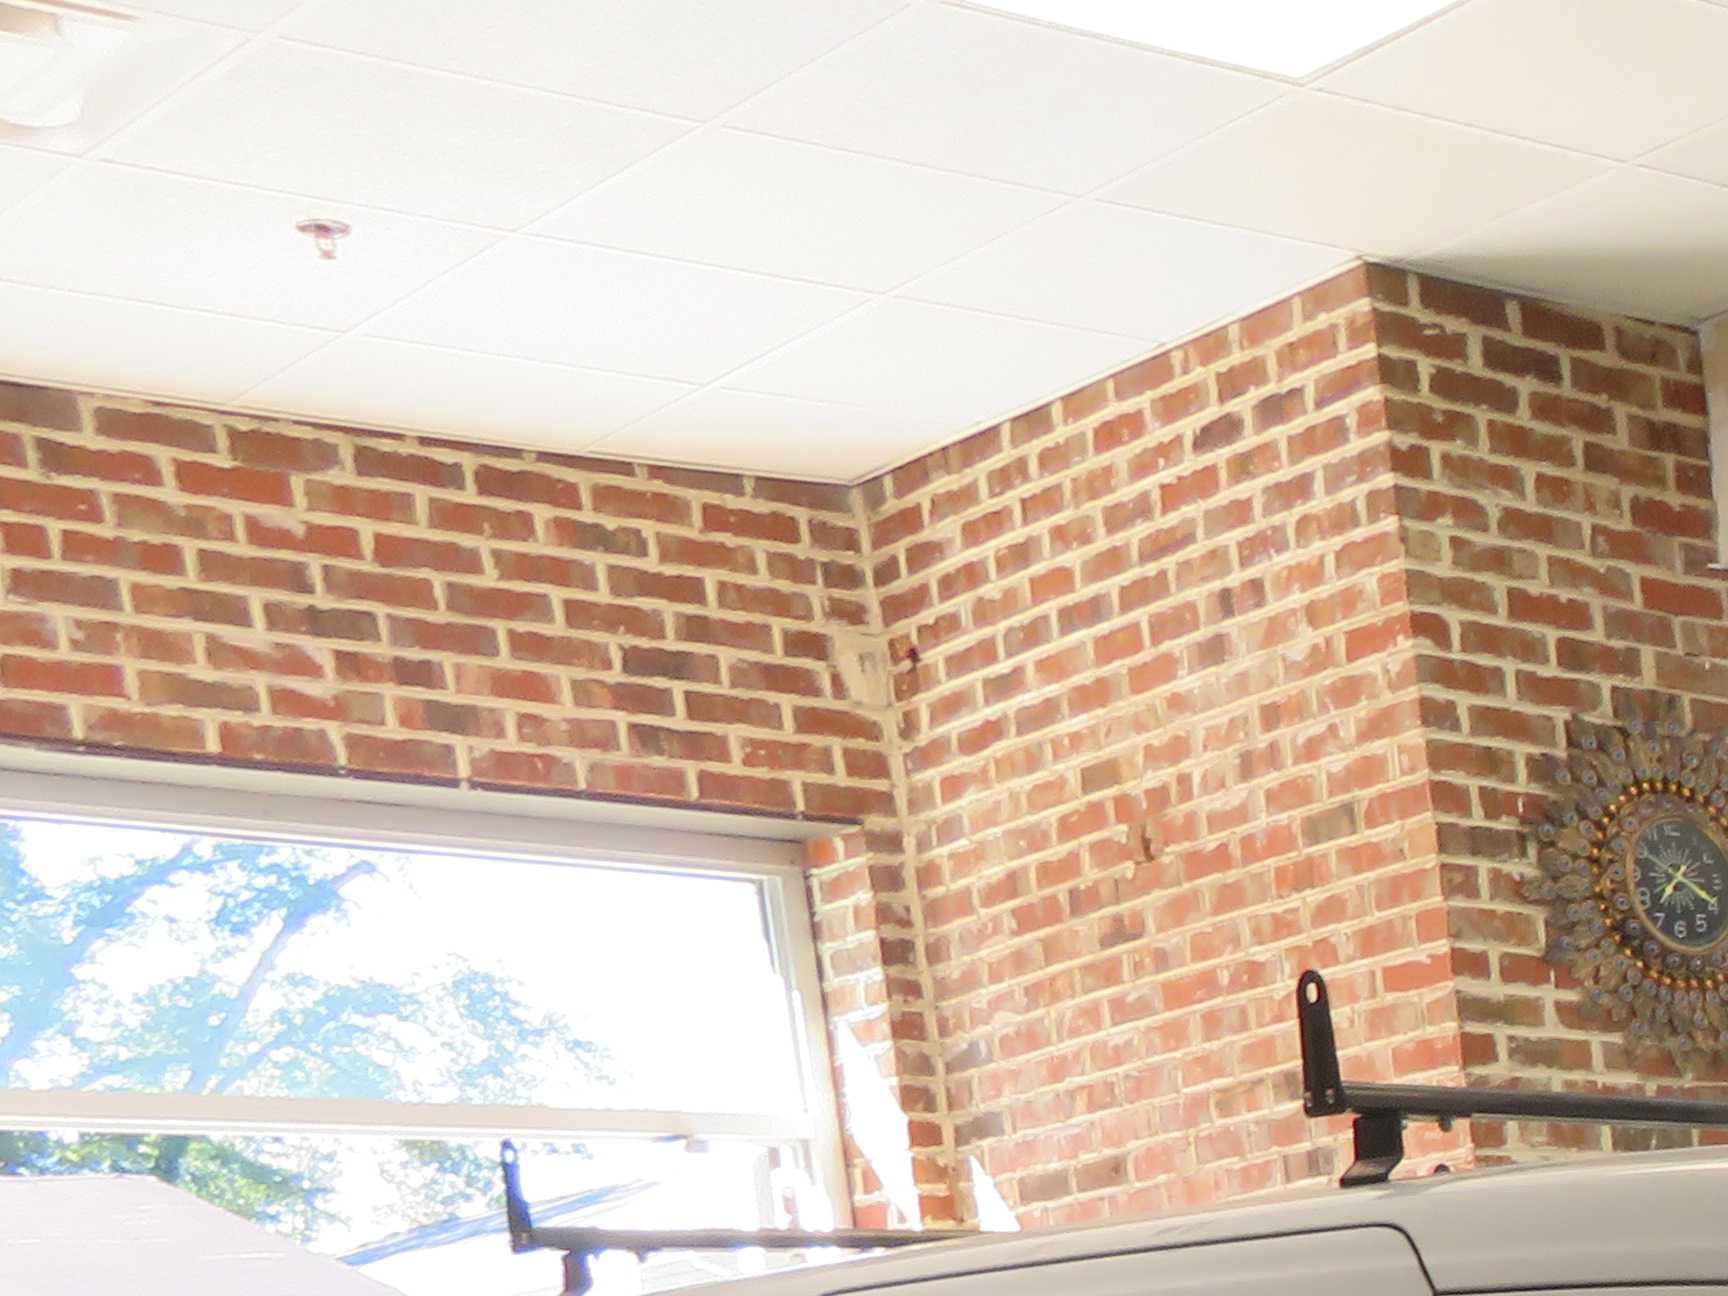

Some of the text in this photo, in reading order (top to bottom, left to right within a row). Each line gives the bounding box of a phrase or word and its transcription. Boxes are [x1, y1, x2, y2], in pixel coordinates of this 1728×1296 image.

[1653, 912, 1666, 929] 7
[1674, 920, 1687, 939] 6
[1695, 914, 1708, 933] 5
